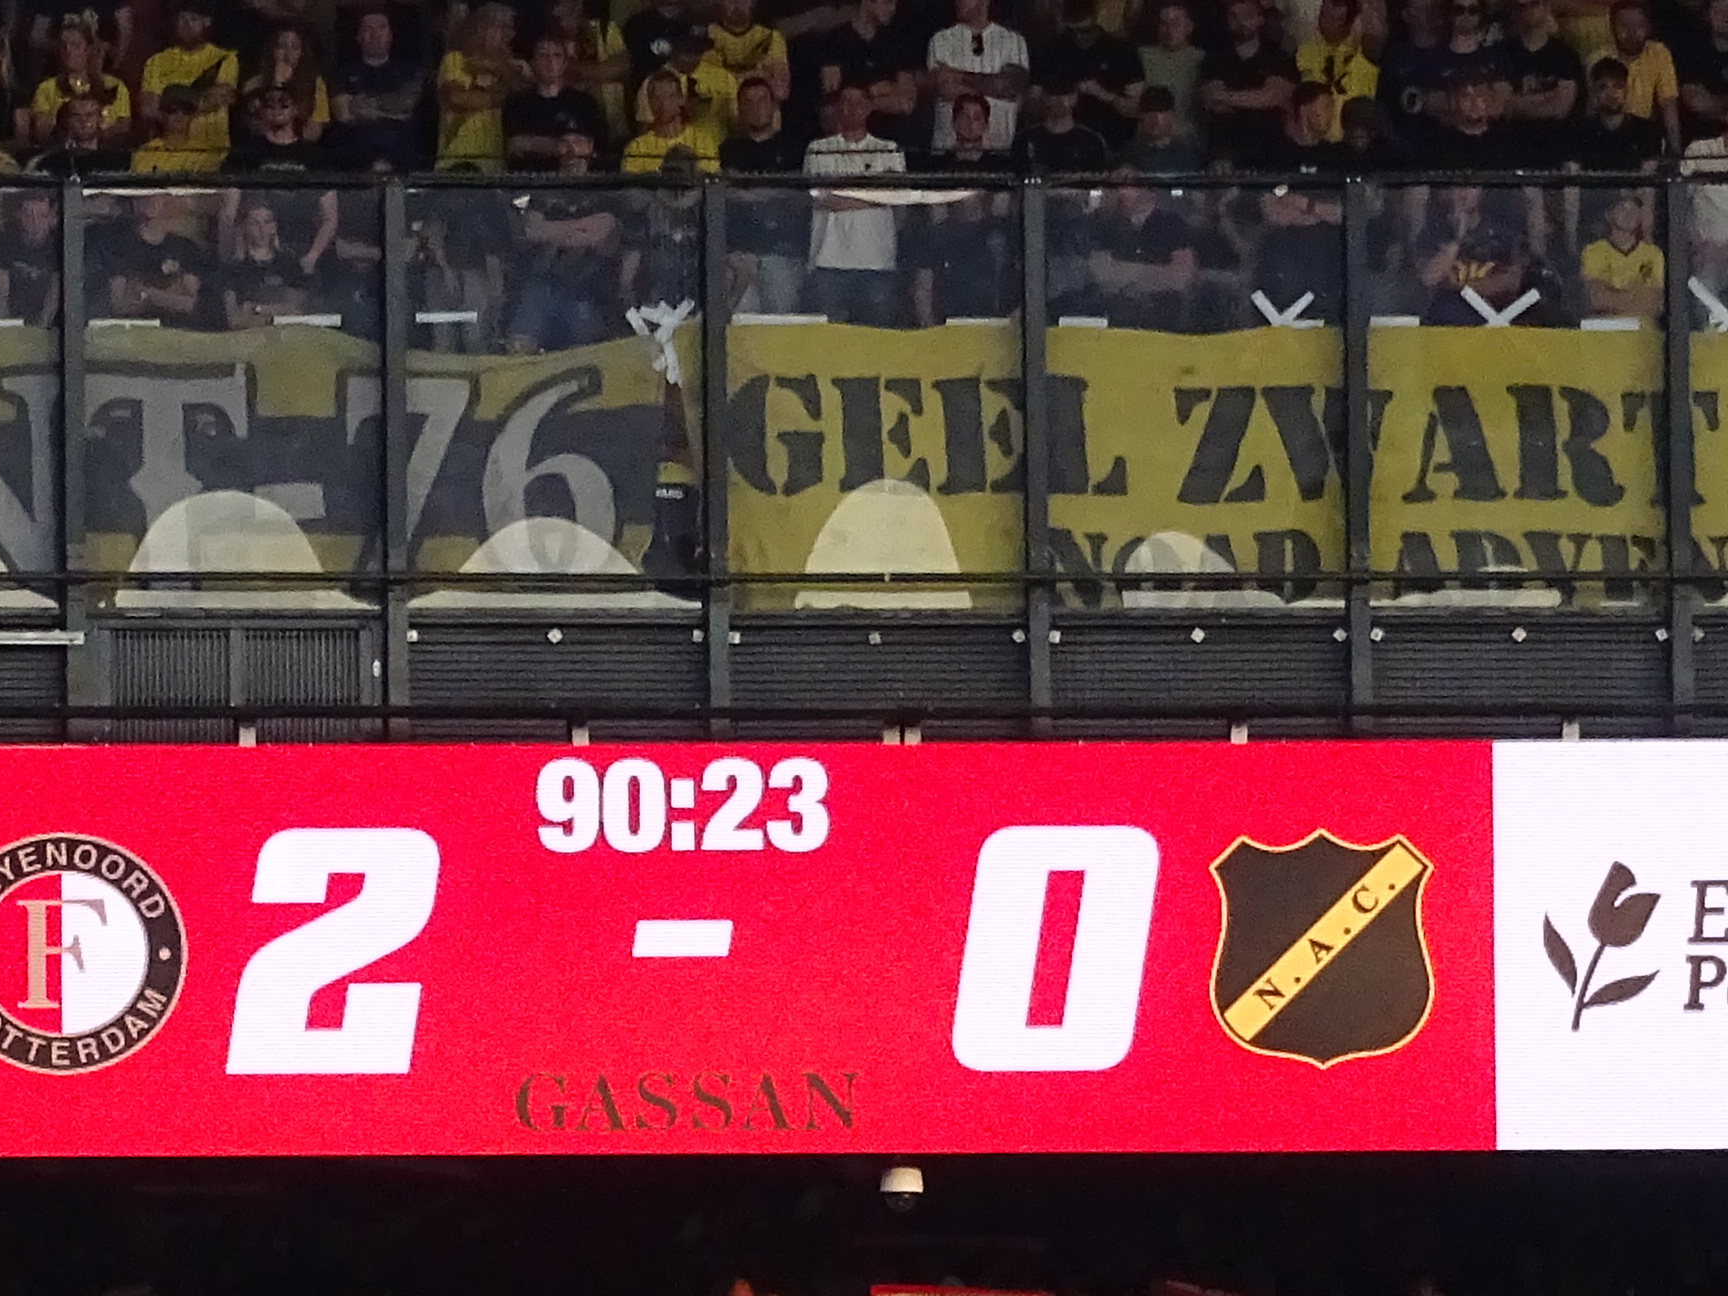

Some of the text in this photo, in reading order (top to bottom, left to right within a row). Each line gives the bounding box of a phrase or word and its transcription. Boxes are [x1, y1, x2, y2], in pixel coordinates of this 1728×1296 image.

[726, 375, 1128, 498] GEEL
[1175, 385, 1719, 508] ZWART
[537, 757, 829, 853] 90:23
[16, 898, 108, 1009] F
[225, 827, 440, 1075] 2
[952, 825, 1160, 1073] 0
[515, 1072, 862, 1132] GASSAN
